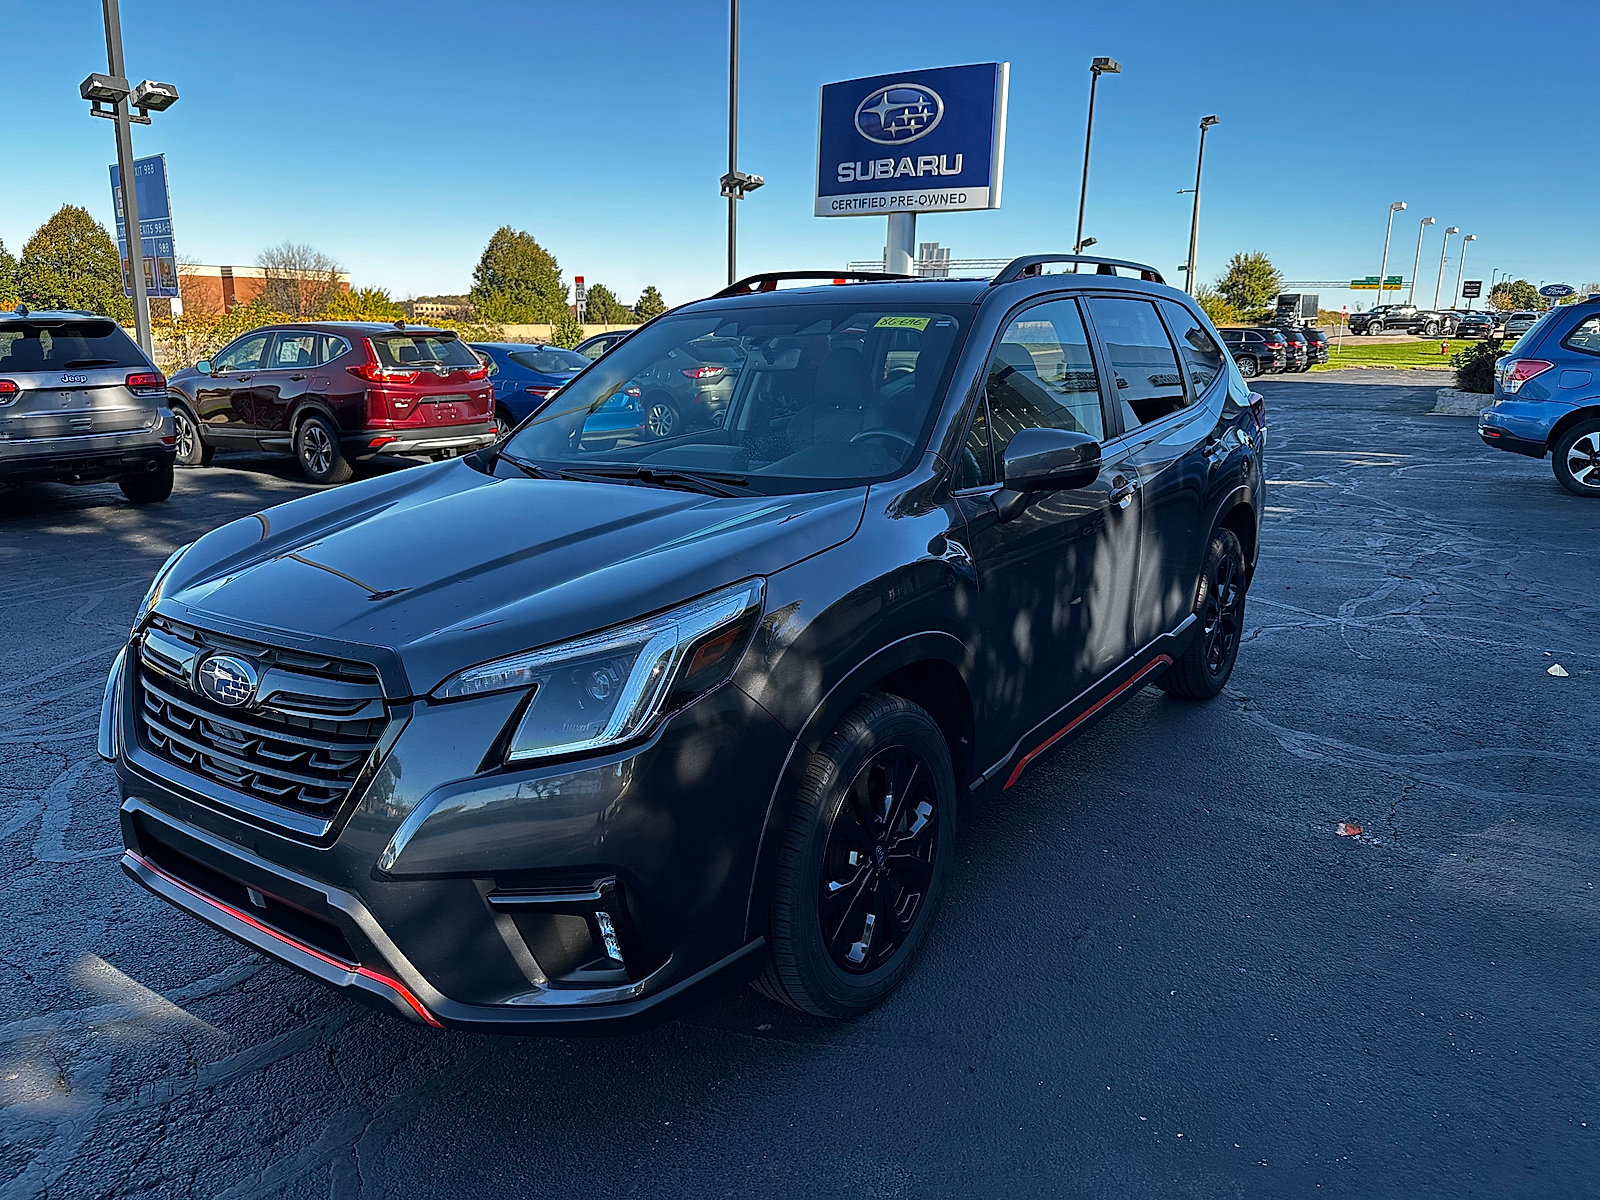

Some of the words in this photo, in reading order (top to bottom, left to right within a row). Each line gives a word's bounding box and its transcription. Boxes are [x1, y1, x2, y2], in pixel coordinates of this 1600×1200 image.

[134, 165, 143, 177] XIT
[837, 153, 963, 183] SUBARU
[831, 196, 887, 211] CERTIFIED
[890, 192, 967, 207] PRE-OWNED
[1545, 287, 1568, 295] Ford
[61, 374, 88, 383] Jeep
